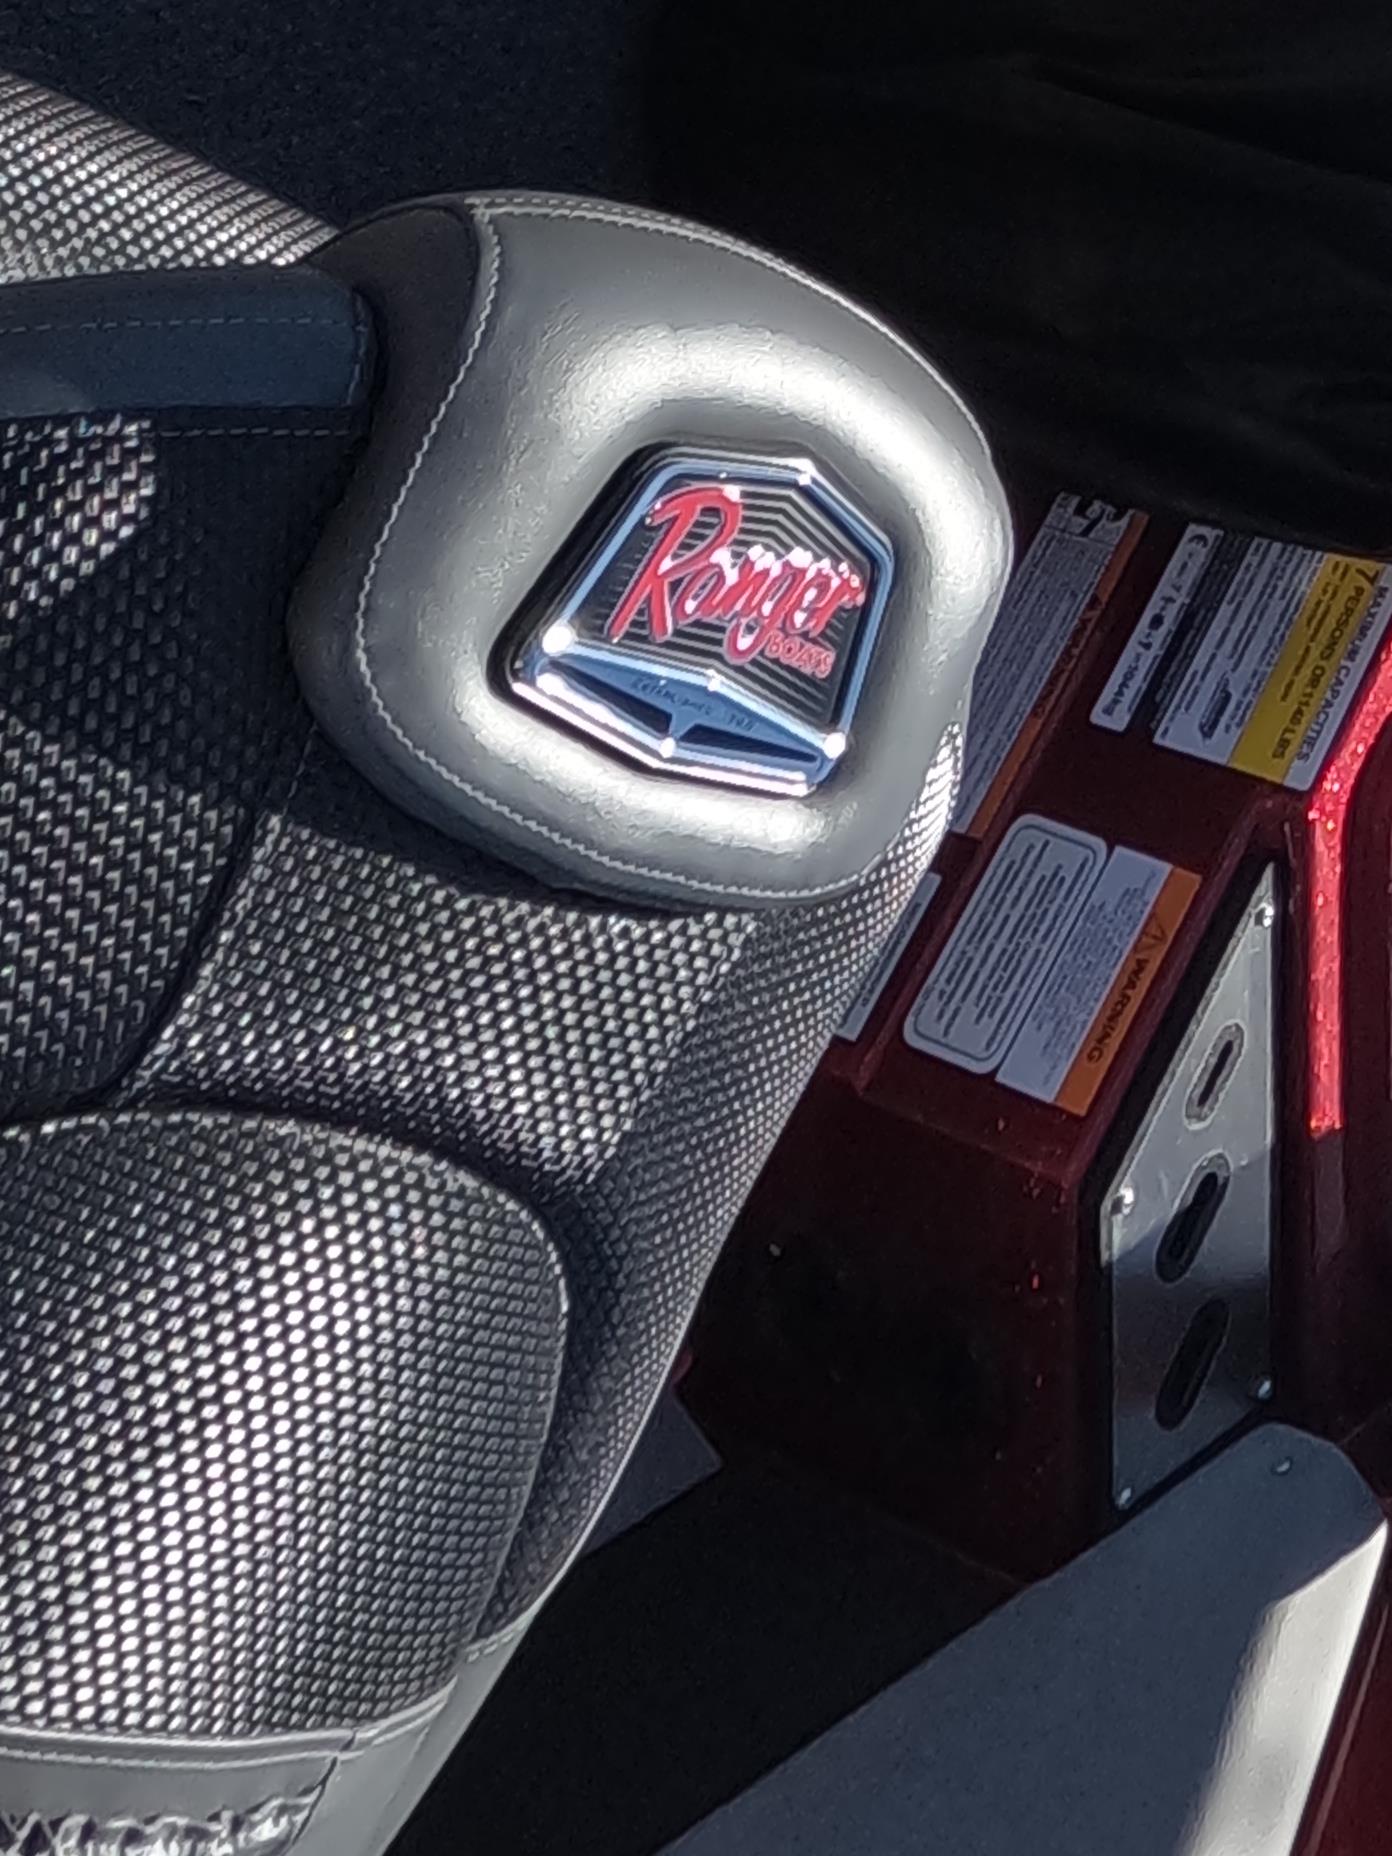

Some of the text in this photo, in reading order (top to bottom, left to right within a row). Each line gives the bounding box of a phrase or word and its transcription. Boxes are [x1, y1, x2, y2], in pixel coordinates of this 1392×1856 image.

[605, 487, 866, 665] Ranger
[1341, 581, 1391, 664] MAXIMUM
[764, 634, 836, 680] BOATS
[1316, 582, 1367, 665] PERSONS
[1293, 662, 1353, 765] CAPACITIES
[1083, 952, 1151, 1068] WARNING
